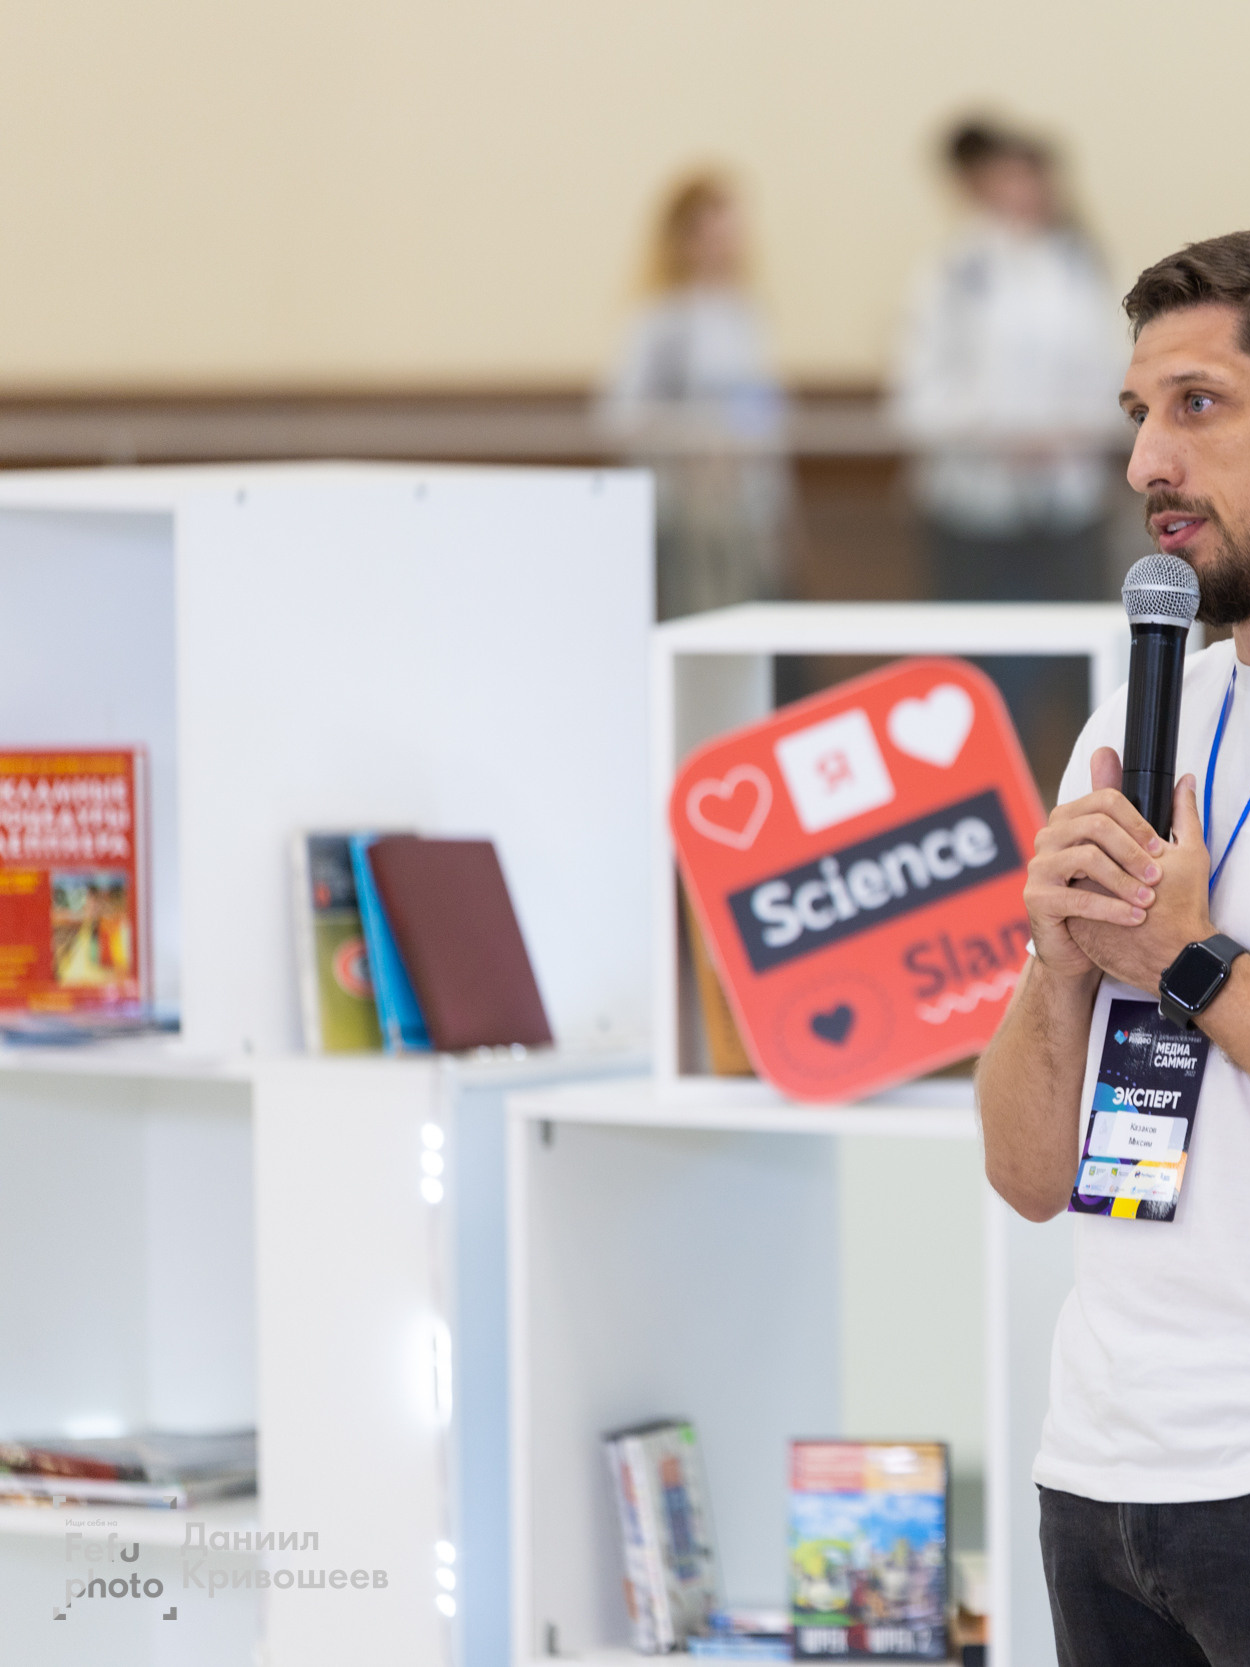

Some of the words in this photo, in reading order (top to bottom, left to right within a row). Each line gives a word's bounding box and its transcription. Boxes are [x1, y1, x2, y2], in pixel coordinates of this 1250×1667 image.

[751, 815, 998, 948] Science
[1156, 1042, 1190, 1056] МЕДИА
[1154, 1056, 1198, 1070] САММИТ
[1112, 1086, 1182, 1109] ЭКСПЕРТ
